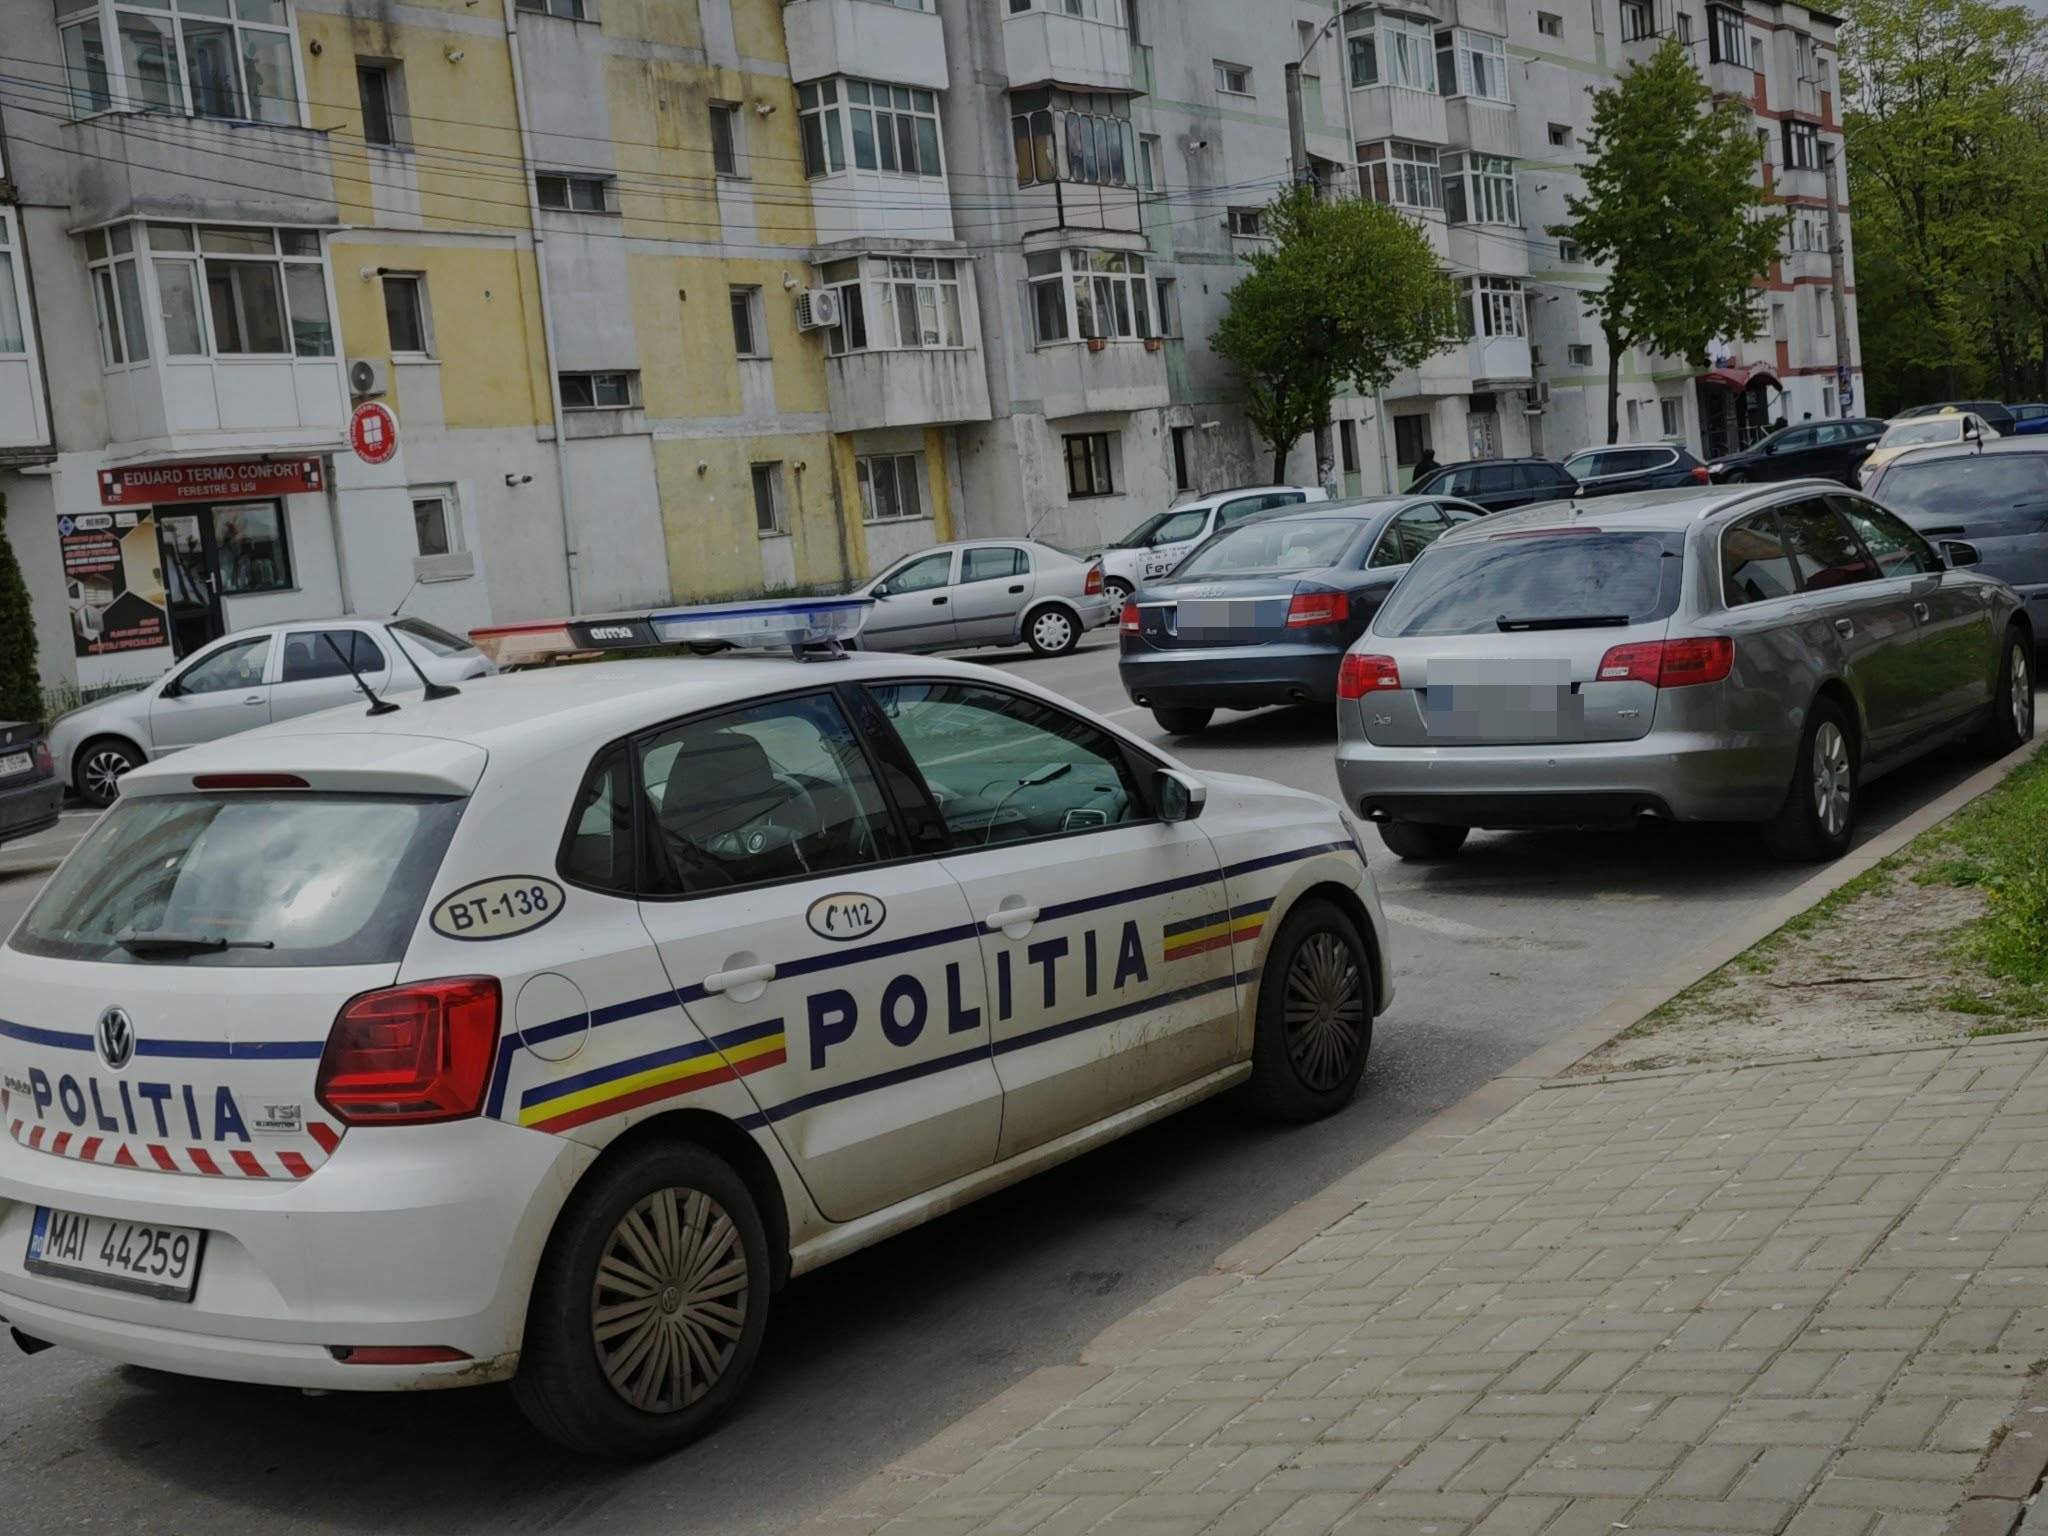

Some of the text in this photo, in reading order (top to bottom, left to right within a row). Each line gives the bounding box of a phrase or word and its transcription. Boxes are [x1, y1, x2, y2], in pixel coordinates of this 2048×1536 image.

[124, 463, 300, 487] EDUARD TERMO CONFORT
[177, 482, 257, 497] FERESTRE SI USI
[1145, 562, 1177, 575] Fer
[449, 885, 550, 932] BT-138
[842, 902, 873, 929] 112
[806, 919, 1149, 1071] POLITIA
[28, 1067, 252, 1143] POLITIA
[264, 1104, 301, 1120] TSI
[32, 1234, 45, 1254] RO
[45, 1212, 190, 1280] MAI 44259
